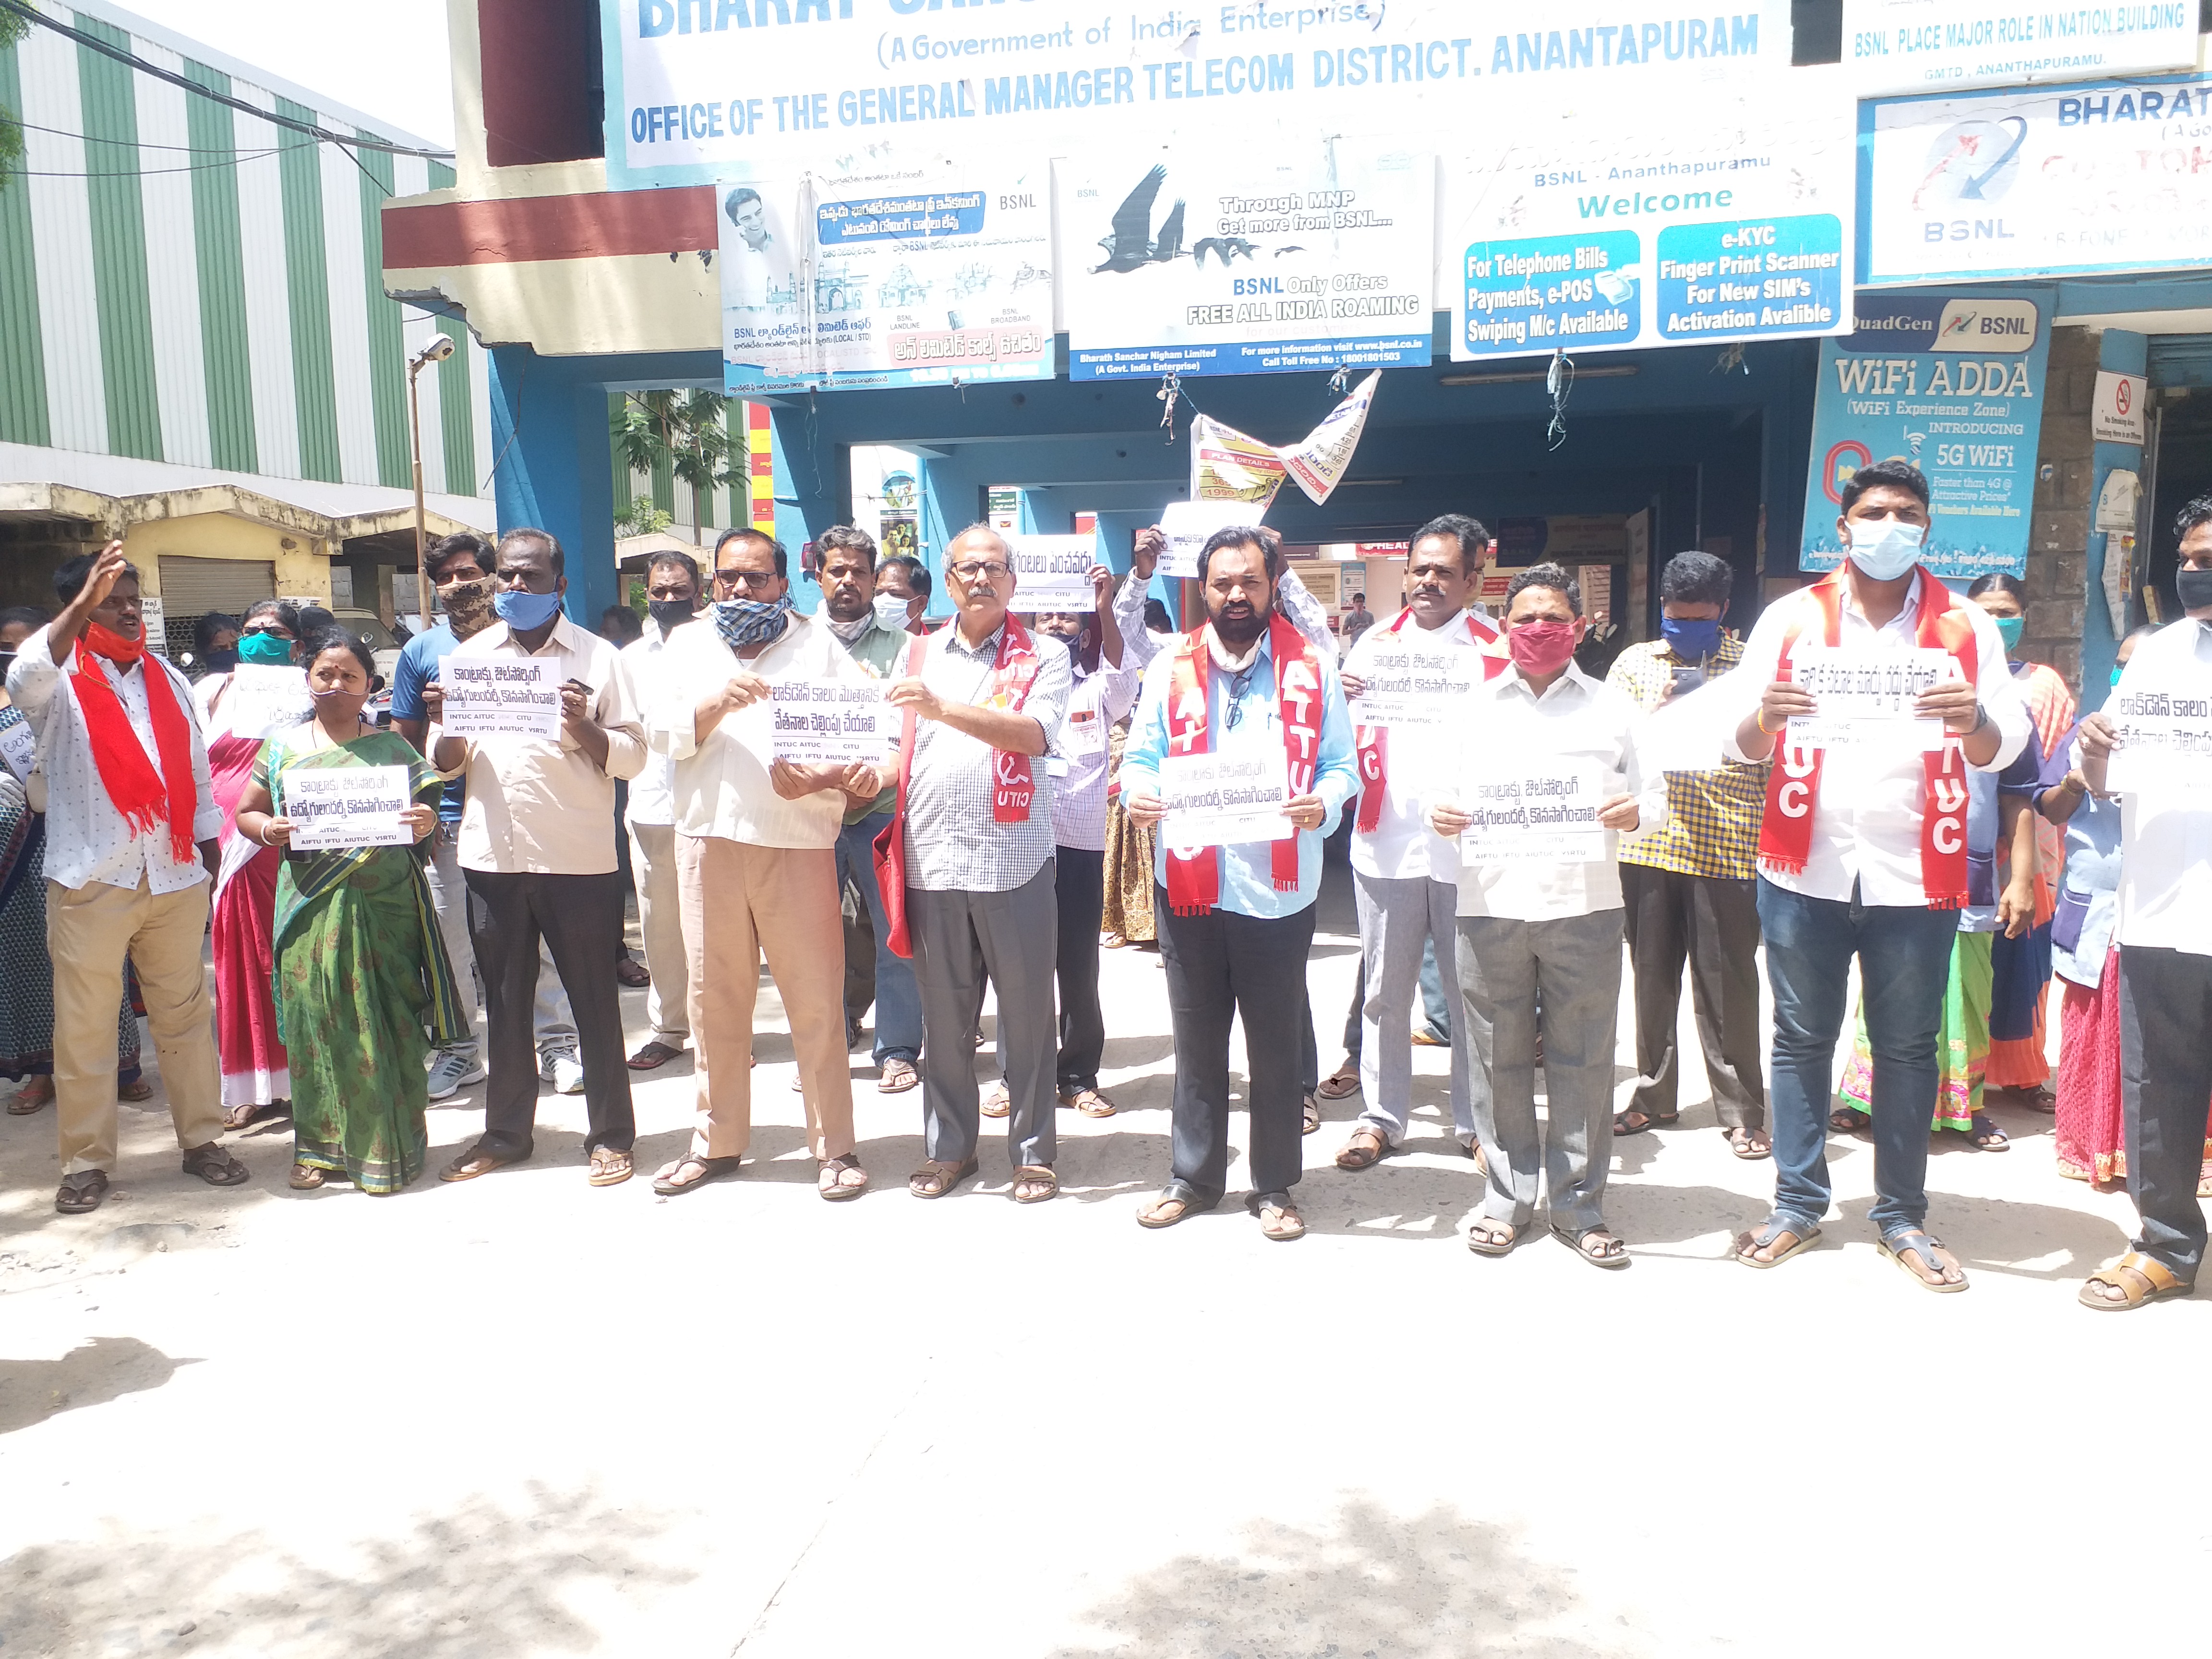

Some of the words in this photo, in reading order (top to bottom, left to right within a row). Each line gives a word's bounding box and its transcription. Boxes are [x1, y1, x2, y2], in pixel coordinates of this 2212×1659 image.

[913, 22, 1073, 60] Government
[1086, 17, 1112, 44] of
[1132, 11, 1201, 40] India
[1221, 2, 1385, 34] Enterprise)
[1855, 31, 1888, 57] BSNL
[1899, 25, 1941, 52] PLACE
[1946, 20, 1993, 47] MAJOR
[1998, 15, 2034, 43] ROLE
[2039, 14, 2053, 39] IN
[2058, 9, 2112, 37] NATION
[2117, 2, 2185, 32] BUILDING
[1925, 67, 1962, 80] GMTD
[1975, 53, 2107, 76] ANANTHAPURAMU.
[631, 102, 724, 143] OFFICE
[730, 99, 763, 135] OF
[773, 94, 828, 132] THE
[838, 80, 974, 126] GENERAL
[985, 67, 1135, 115] MANAGER
[1143, 53, 1293, 100] TELECOM
[1314, 39, 1481, 87] DISTRICT.
[1491, 14, 1758, 74] ANANTAPURAM
[2058, 87, 2212, 127] BHARAT
[1535, 170, 1587, 187] BSNL
[1608, 157, 1770, 180] Ananthapuramu
[1000, 194, 1036, 210] BSNL
[1078, 189, 1100, 198] BSNL
[1219, 193, 1303, 215] Through
[1308, 190, 1355, 209] MNP
[1577, 190, 1732, 218] Welcome
[1217, 217, 1246, 235] Get
[1249, 218, 1290, 233] more
[1293, 214, 1331, 230] from
[1924, 219, 2015, 242] BSNL
[1721, 226, 1775, 249] e-KYC
[1468, 256, 1492, 278] For
[1495, 251, 1571, 279] Telephone
[1575, 246, 1608, 270] Bills
[1660, 260, 1716, 282] Finger
[1719, 255, 1761, 275] Print
[1765, 252, 1840, 272] Scanner
[1233, 276, 1285, 296] BSNL
[1287, 276, 1328, 297] Only
[1332, 273, 1389, 291] Offers
[1468, 285, 1544, 315] Payments,
[1547, 278, 1593, 305] e-POS
[1687, 285, 1717, 304] For
[1719, 281, 1759, 301] New
[991, 315, 1031, 324] BROADBAND
[1187, 305, 1234, 325] FREE
[1237, 302, 1272, 323] ALL
[1276, 299, 1325, 322] INDIA
[1331, 295, 1419, 318] ROAMING
[1667, 310, 1756, 332] Activation
[1760, 303, 1832, 325] Avalible
[734, 328, 758, 339] BSNL
[890, 322, 921, 330] LANDLINE
[1467, 317, 1526, 346] Swiping
[1530, 313, 1556, 337] M/c
[1558, 308, 1629, 335] Available
[1980, 316, 2030, 336] BSNL
[833, 333, 854, 344] (LOCAL
[1241, 347, 1255, 357] For
[1257, 348, 1279, 356] more
[1281, 343, 1332, 354] information
[1334, 342, 1354, 352] visit
[1080, 353, 1113, 364] Bharath
[1114, 351, 1148, 362] Sanchar
[1150, 351, 1182, 362] Nigham
[1184, 349, 1216, 359] Limited
[1095, 365, 1105, 375] (A
[1106, 364, 1129, 374] Govt.
[1130, 363, 1151, 373] India
[1153, 361, 1200, 374] Enterprise)
[1262, 357, 1280, 367] Call
[1281, 356, 1297, 366] Toll
[1299, 356, 1320, 366] Free
[1322, 355, 1334, 364] No
[1835, 359, 1917, 396] WiFi
[1925, 359, 2032, 397] ADDA
[1847, 399, 1890, 416] (WiFi
[1895, 400, 1968, 417] Experience
[1973, 401, 2010, 418] Zone)
[1929, 422, 2024, 435] INTRODUCING
[1211, 452, 1235, 462] PLAN
[1237, 457, 1270, 468] DETAILS
[1936, 444, 1965, 466] 5G
[1968, 445, 2014, 468] WiFi
[1933, 476, 1962, 488] Faster
[1963, 478, 1985, 489] than
[1987, 479, 2001, 489] 4G
[2002, 479, 2012, 490] @
[1932, 489, 1977, 501] Attractive
